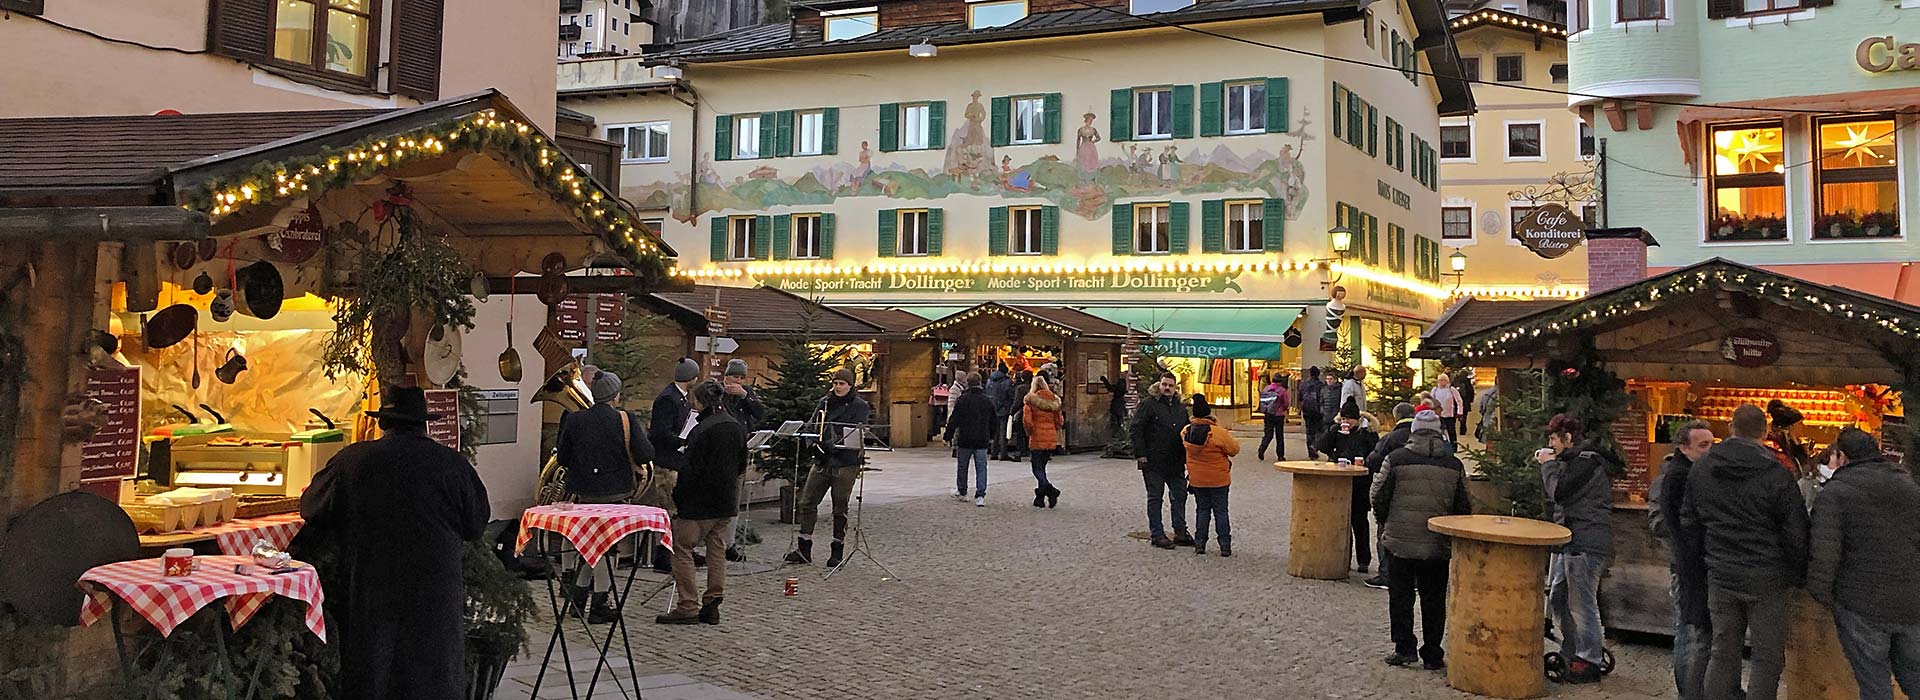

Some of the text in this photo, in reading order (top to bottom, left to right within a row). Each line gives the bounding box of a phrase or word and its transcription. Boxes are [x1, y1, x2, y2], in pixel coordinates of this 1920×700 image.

[1536, 210, 1568, 229] Cafe
[1525, 229, 1581, 238] Konditorei
[1538, 239, 1569, 249] Bistro
[779, 272, 1212, 293] Mode Sport Tracht Dollinger Mode Sport Tracht Dollinger
[710, 358, 721, 367] WC
